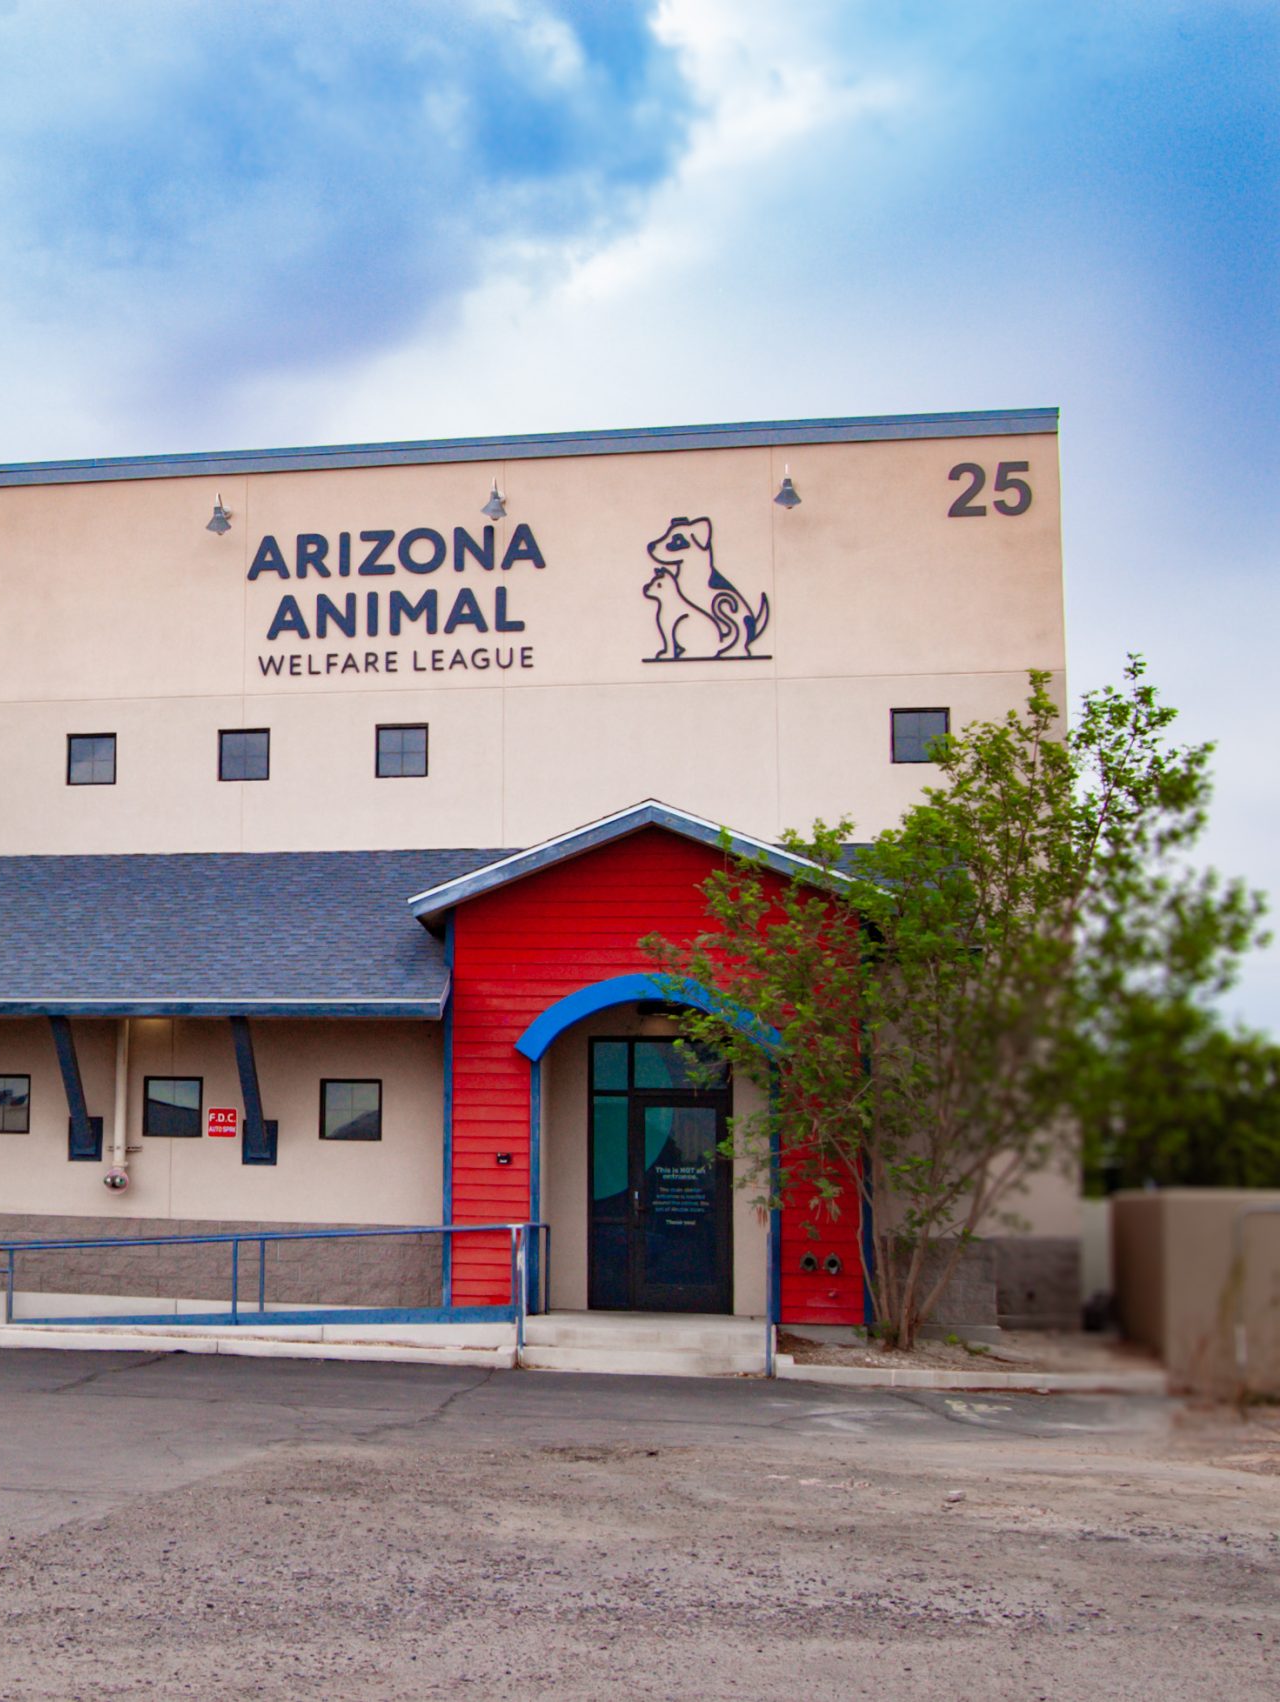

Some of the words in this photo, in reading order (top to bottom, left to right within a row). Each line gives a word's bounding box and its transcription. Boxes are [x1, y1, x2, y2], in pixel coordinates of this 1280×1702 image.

[947, 461, 1032, 518] 25
[247, 523, 546, 581] ARIZONA
[266, 586, 525, 641] ANIMAL
[258, 651, 398, 676] WELFARE
[413, 646, 534, 671] LEAGUE
